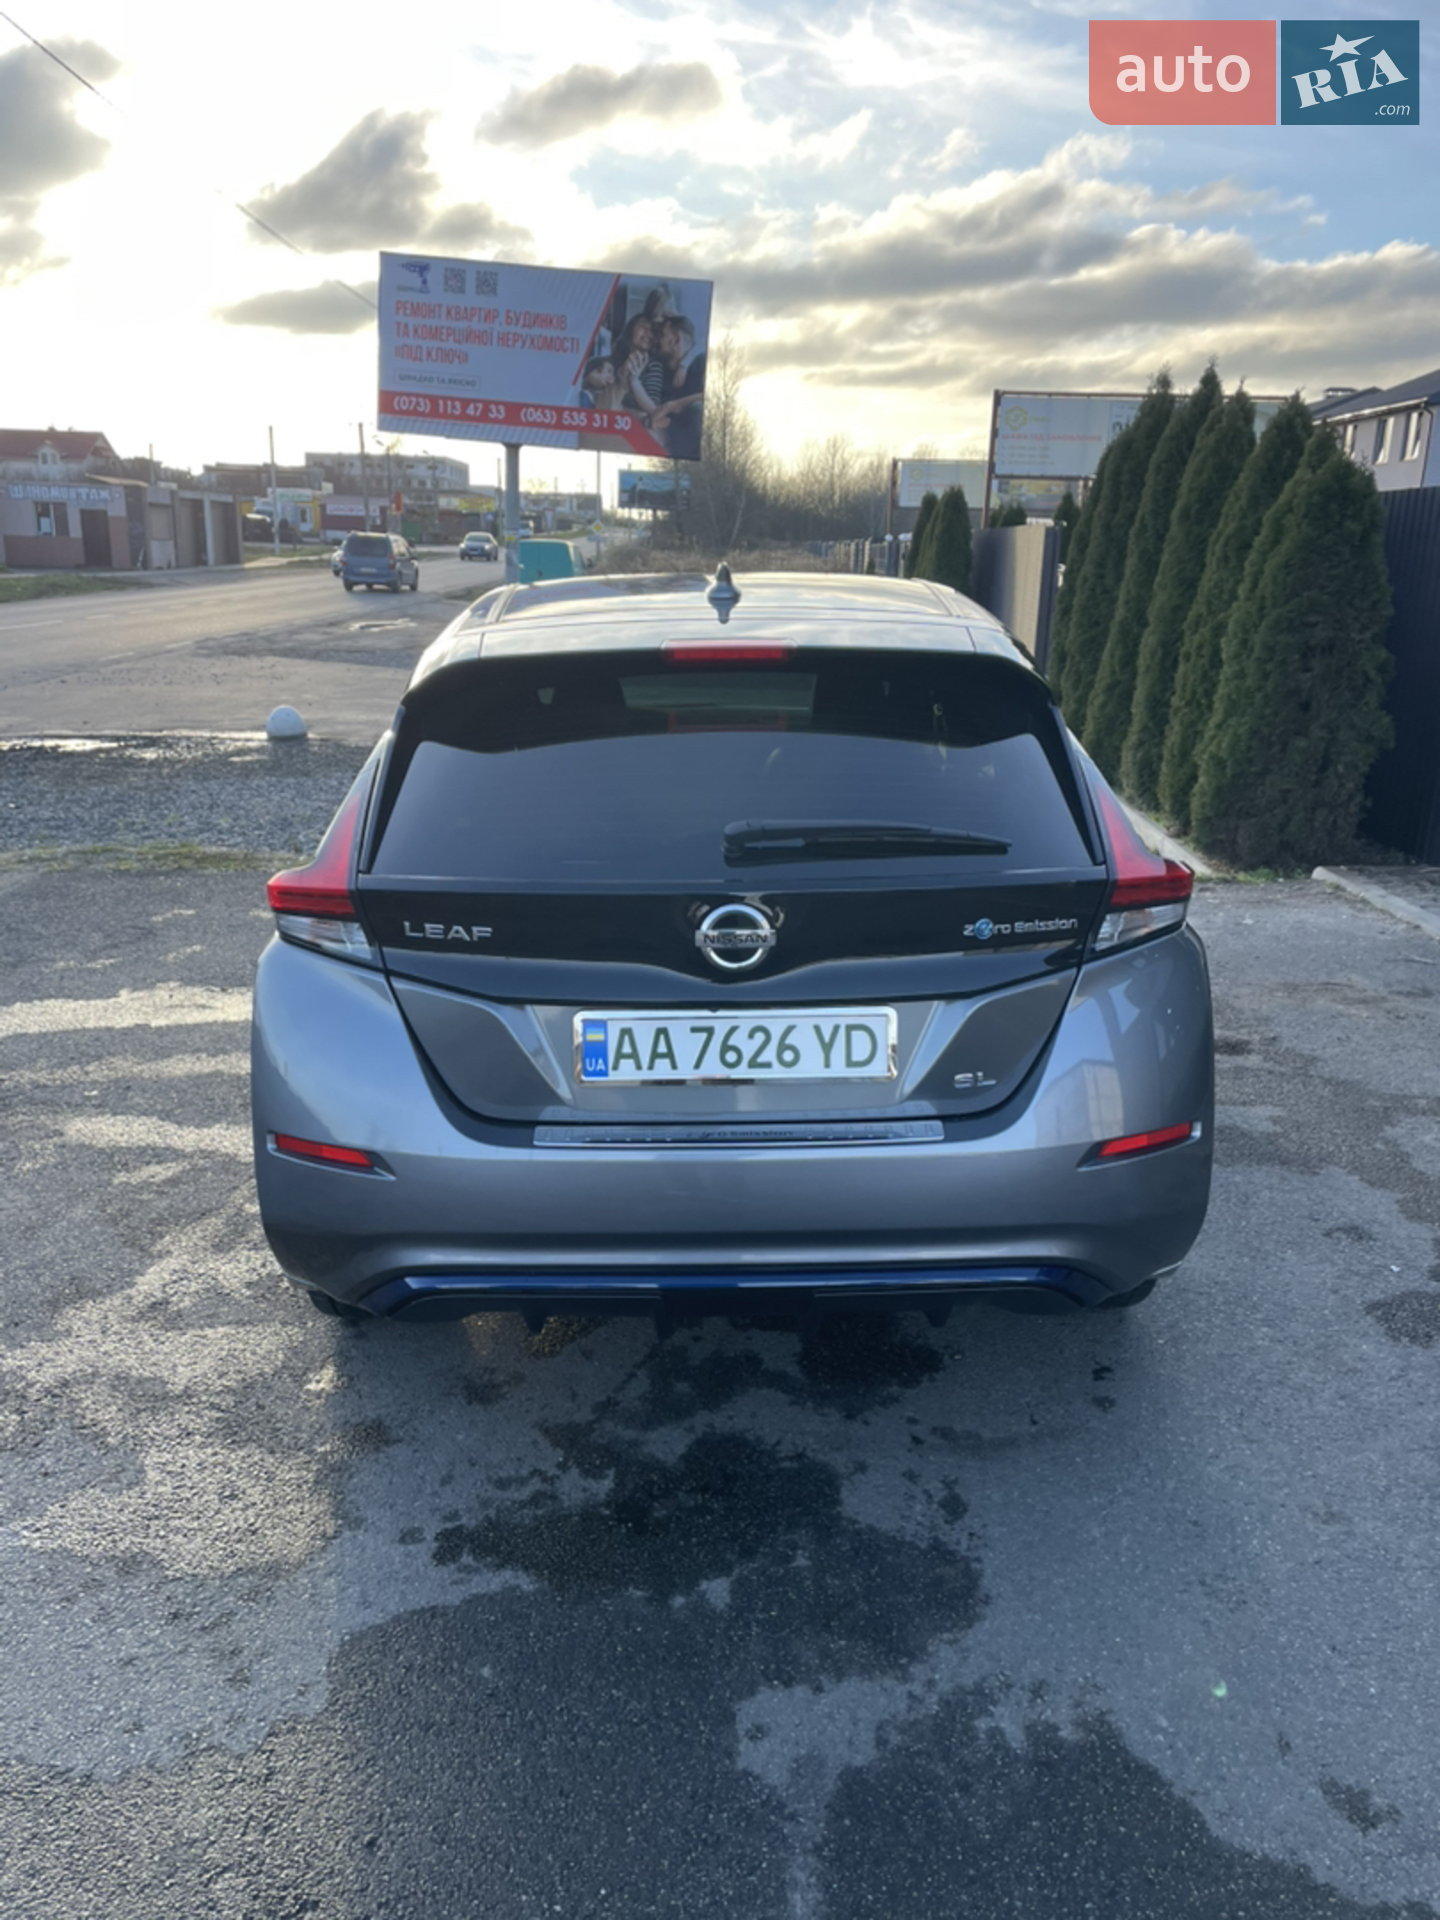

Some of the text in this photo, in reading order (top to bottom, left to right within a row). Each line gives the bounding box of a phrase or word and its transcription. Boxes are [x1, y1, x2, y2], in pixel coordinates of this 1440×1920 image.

[394, 300, 442, 320] РЕМОНТ
[505, 309, 567, 331] БУДИНКІВ
[394, 321, 579, 354] ТА КОМЕРЦІЙНОЇ НЕРУХОМОСТІ
[393, 395, 505, 419] (073) 113 47 33
[520, 407, 632, 431] (063) 535 31 30
[403, 920, 493, 941] LEAF
[703, 934, 769, 945] NISSAN
[611, 1024, 878, 1071] AA 7626 YD
[586, 1058, 606, 1071] UA
[954, 1072, 997, 1088] SL
